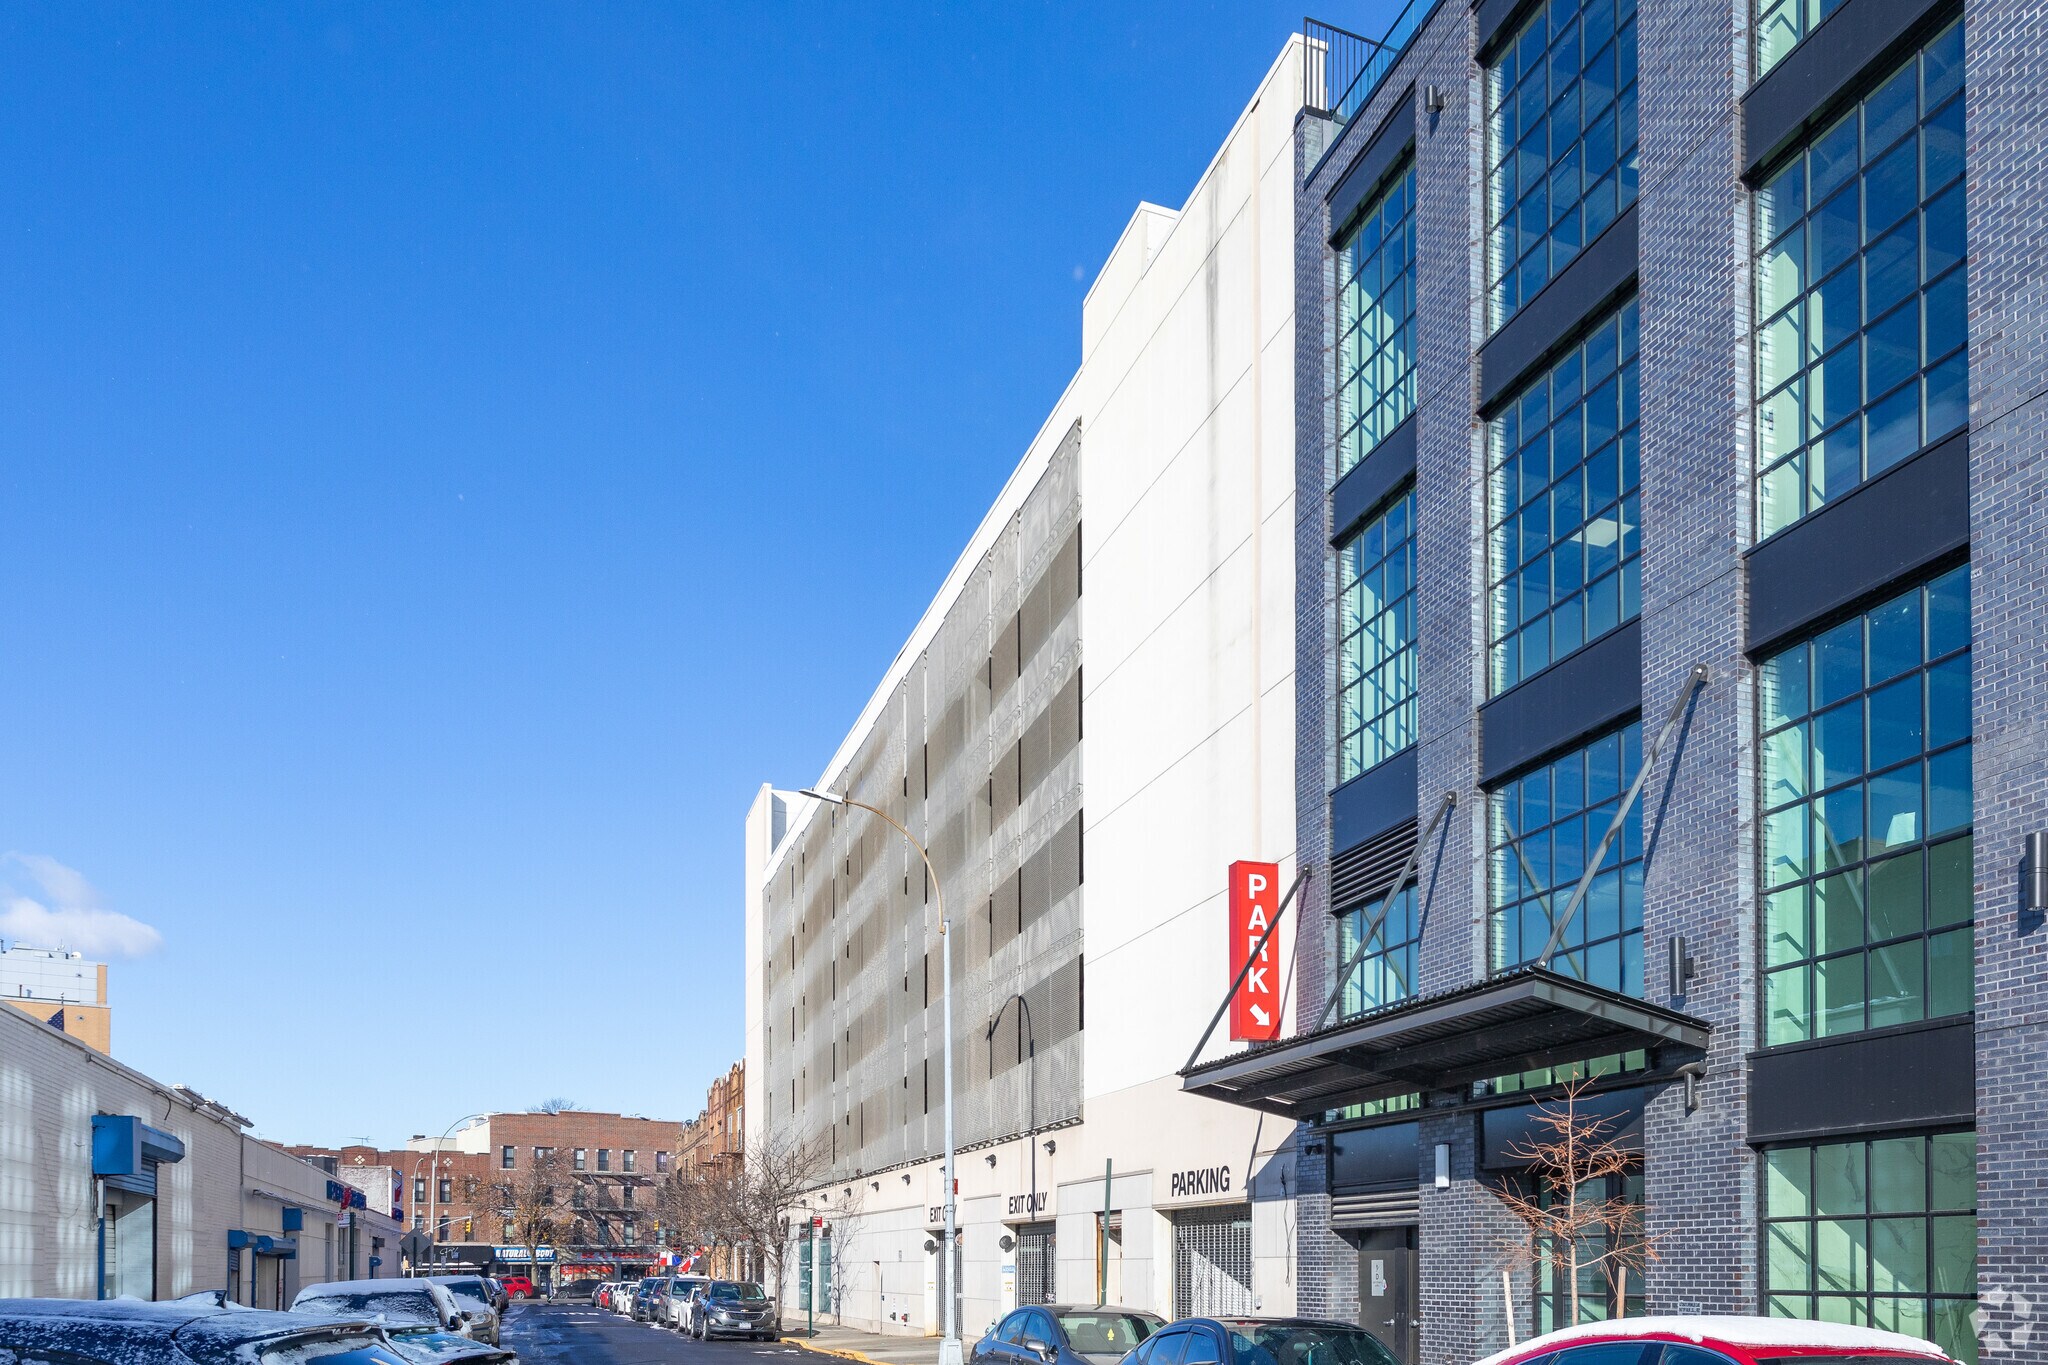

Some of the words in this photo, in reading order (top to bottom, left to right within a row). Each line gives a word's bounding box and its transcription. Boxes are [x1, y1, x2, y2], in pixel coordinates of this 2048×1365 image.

[1248, 873, 1269, 994] PARK
[1171, 1165, 1230, 1197] PARKING
[1009, 1194, 1026, 1214] EXIT
[1027, 1192, 1048, 1213] ONLY
[930, 1207, 942, 1222] EXIT
[495, 1249, 527, 1258] NATURAL
[535, 1249, 554, 1258] BODY
